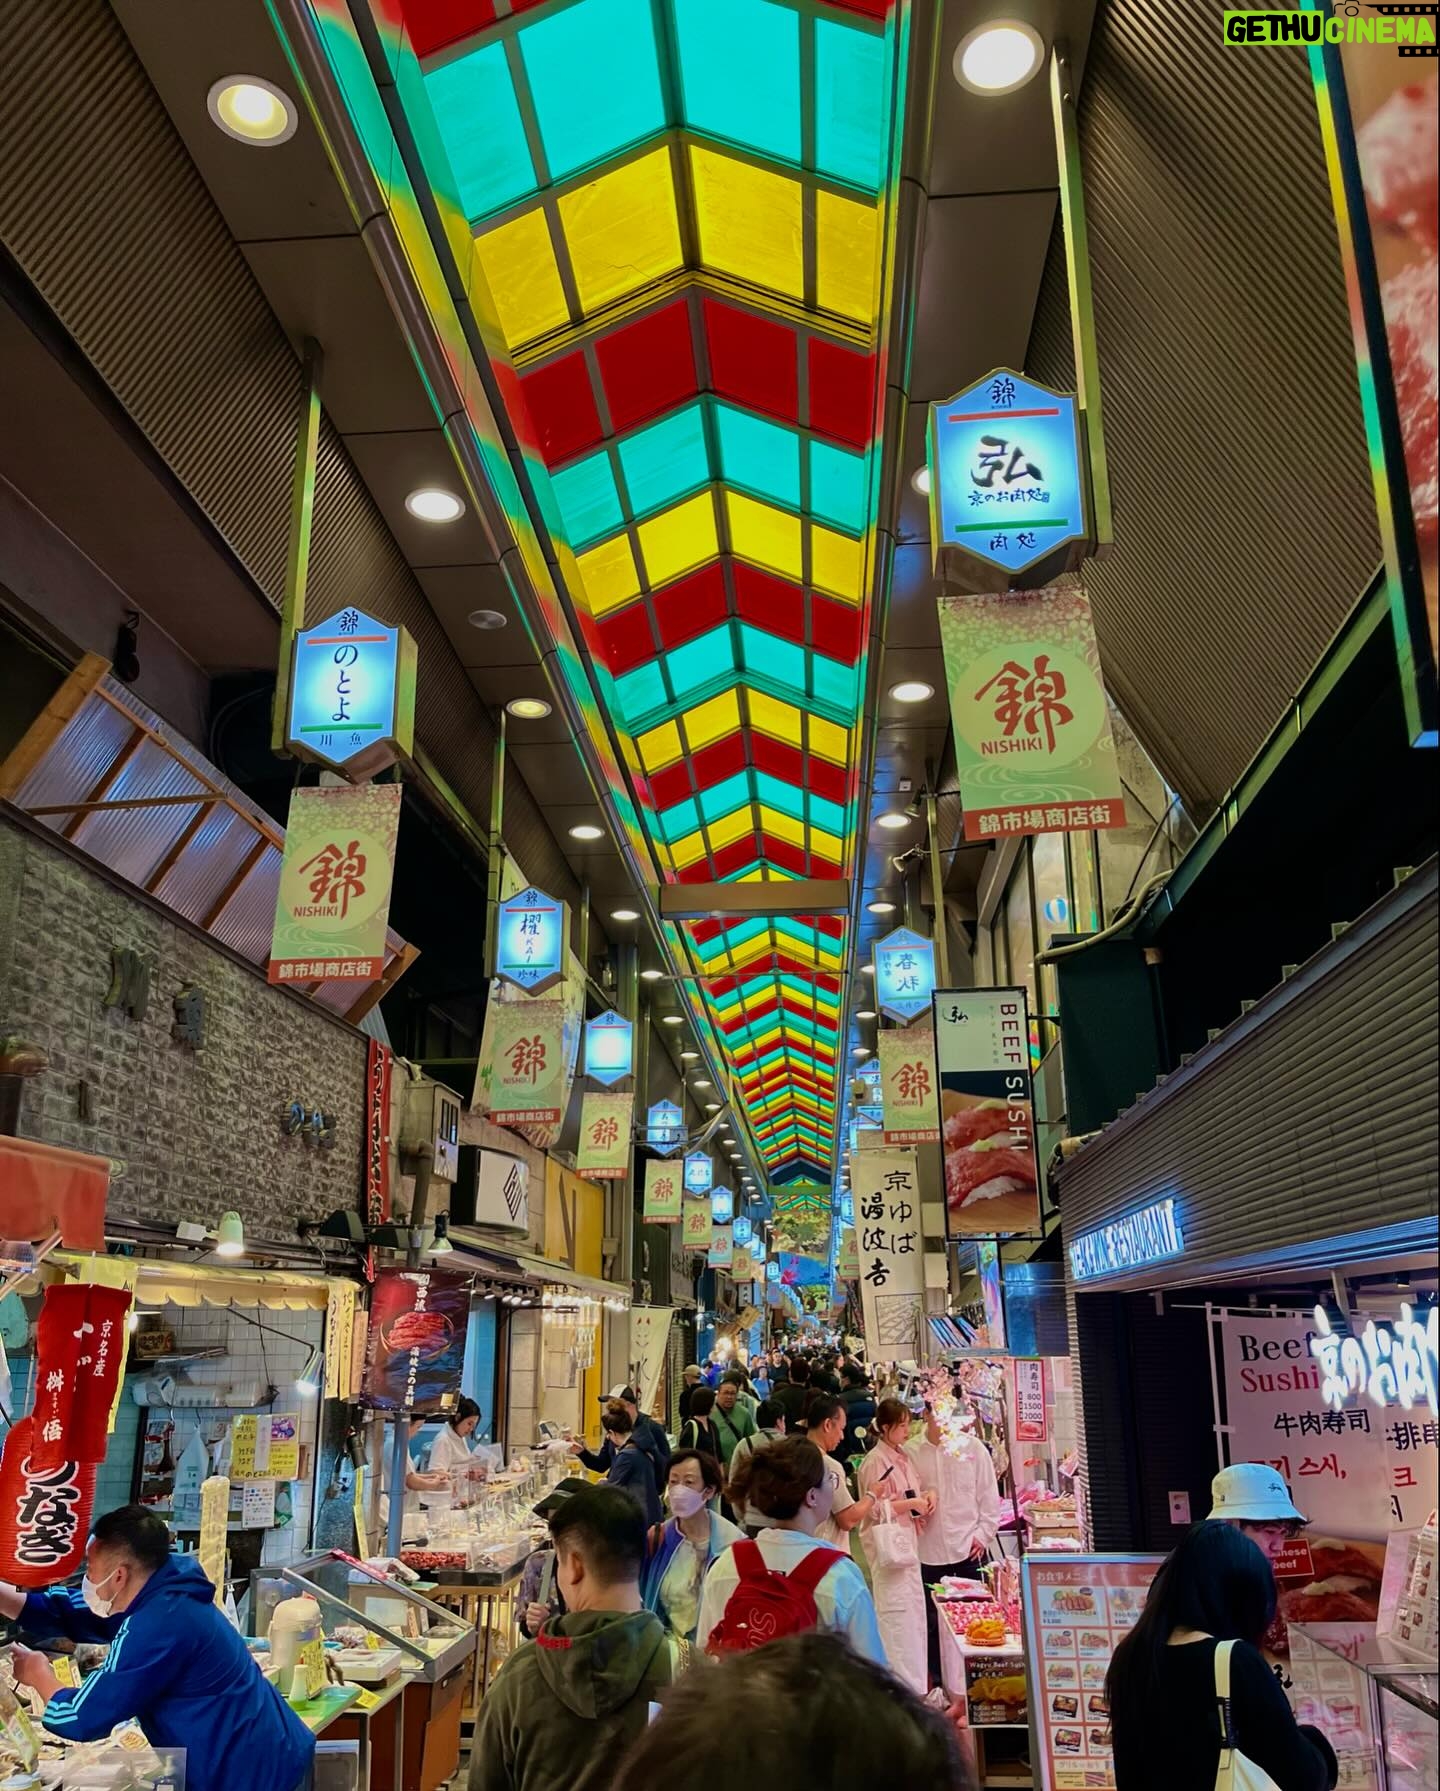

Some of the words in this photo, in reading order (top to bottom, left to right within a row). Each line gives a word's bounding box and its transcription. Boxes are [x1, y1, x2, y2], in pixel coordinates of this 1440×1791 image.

[986, 377, 1016, 407] 錦
[970, 434, 1044, 488] 弘
[332, 645, 359, 722] のとよ
[974, 655, 1074, 753] 錦
[981, 738, 1042, 754] NISHIKI
[978, 804, 1110, 834] 錦市場商店街
[298, 840, 367, 920] 錦
[293, 906, 338, 917] NISHIKI
[278, 961, 373, 979] 錦市場商店街
[1000, 1004, 1022, 1063] BEEF
[504, 1035, 547, 1085] 錦
[891, 1061, 931, 1107] 錦
[1005, 1076, 1029, 1150] SUSHI
[884, 1170, 917, 1255] 京ゆば
[93, 1319, 113, 1377] 京名産
[1239, 1332, 1317, 1361] Beef
[1242, 1366, 1319, 1393] Sushi
[1274, 1409, 1371, 1437] 牛肉寿司
[1298, 1453, 1346, 1480] 스시,
